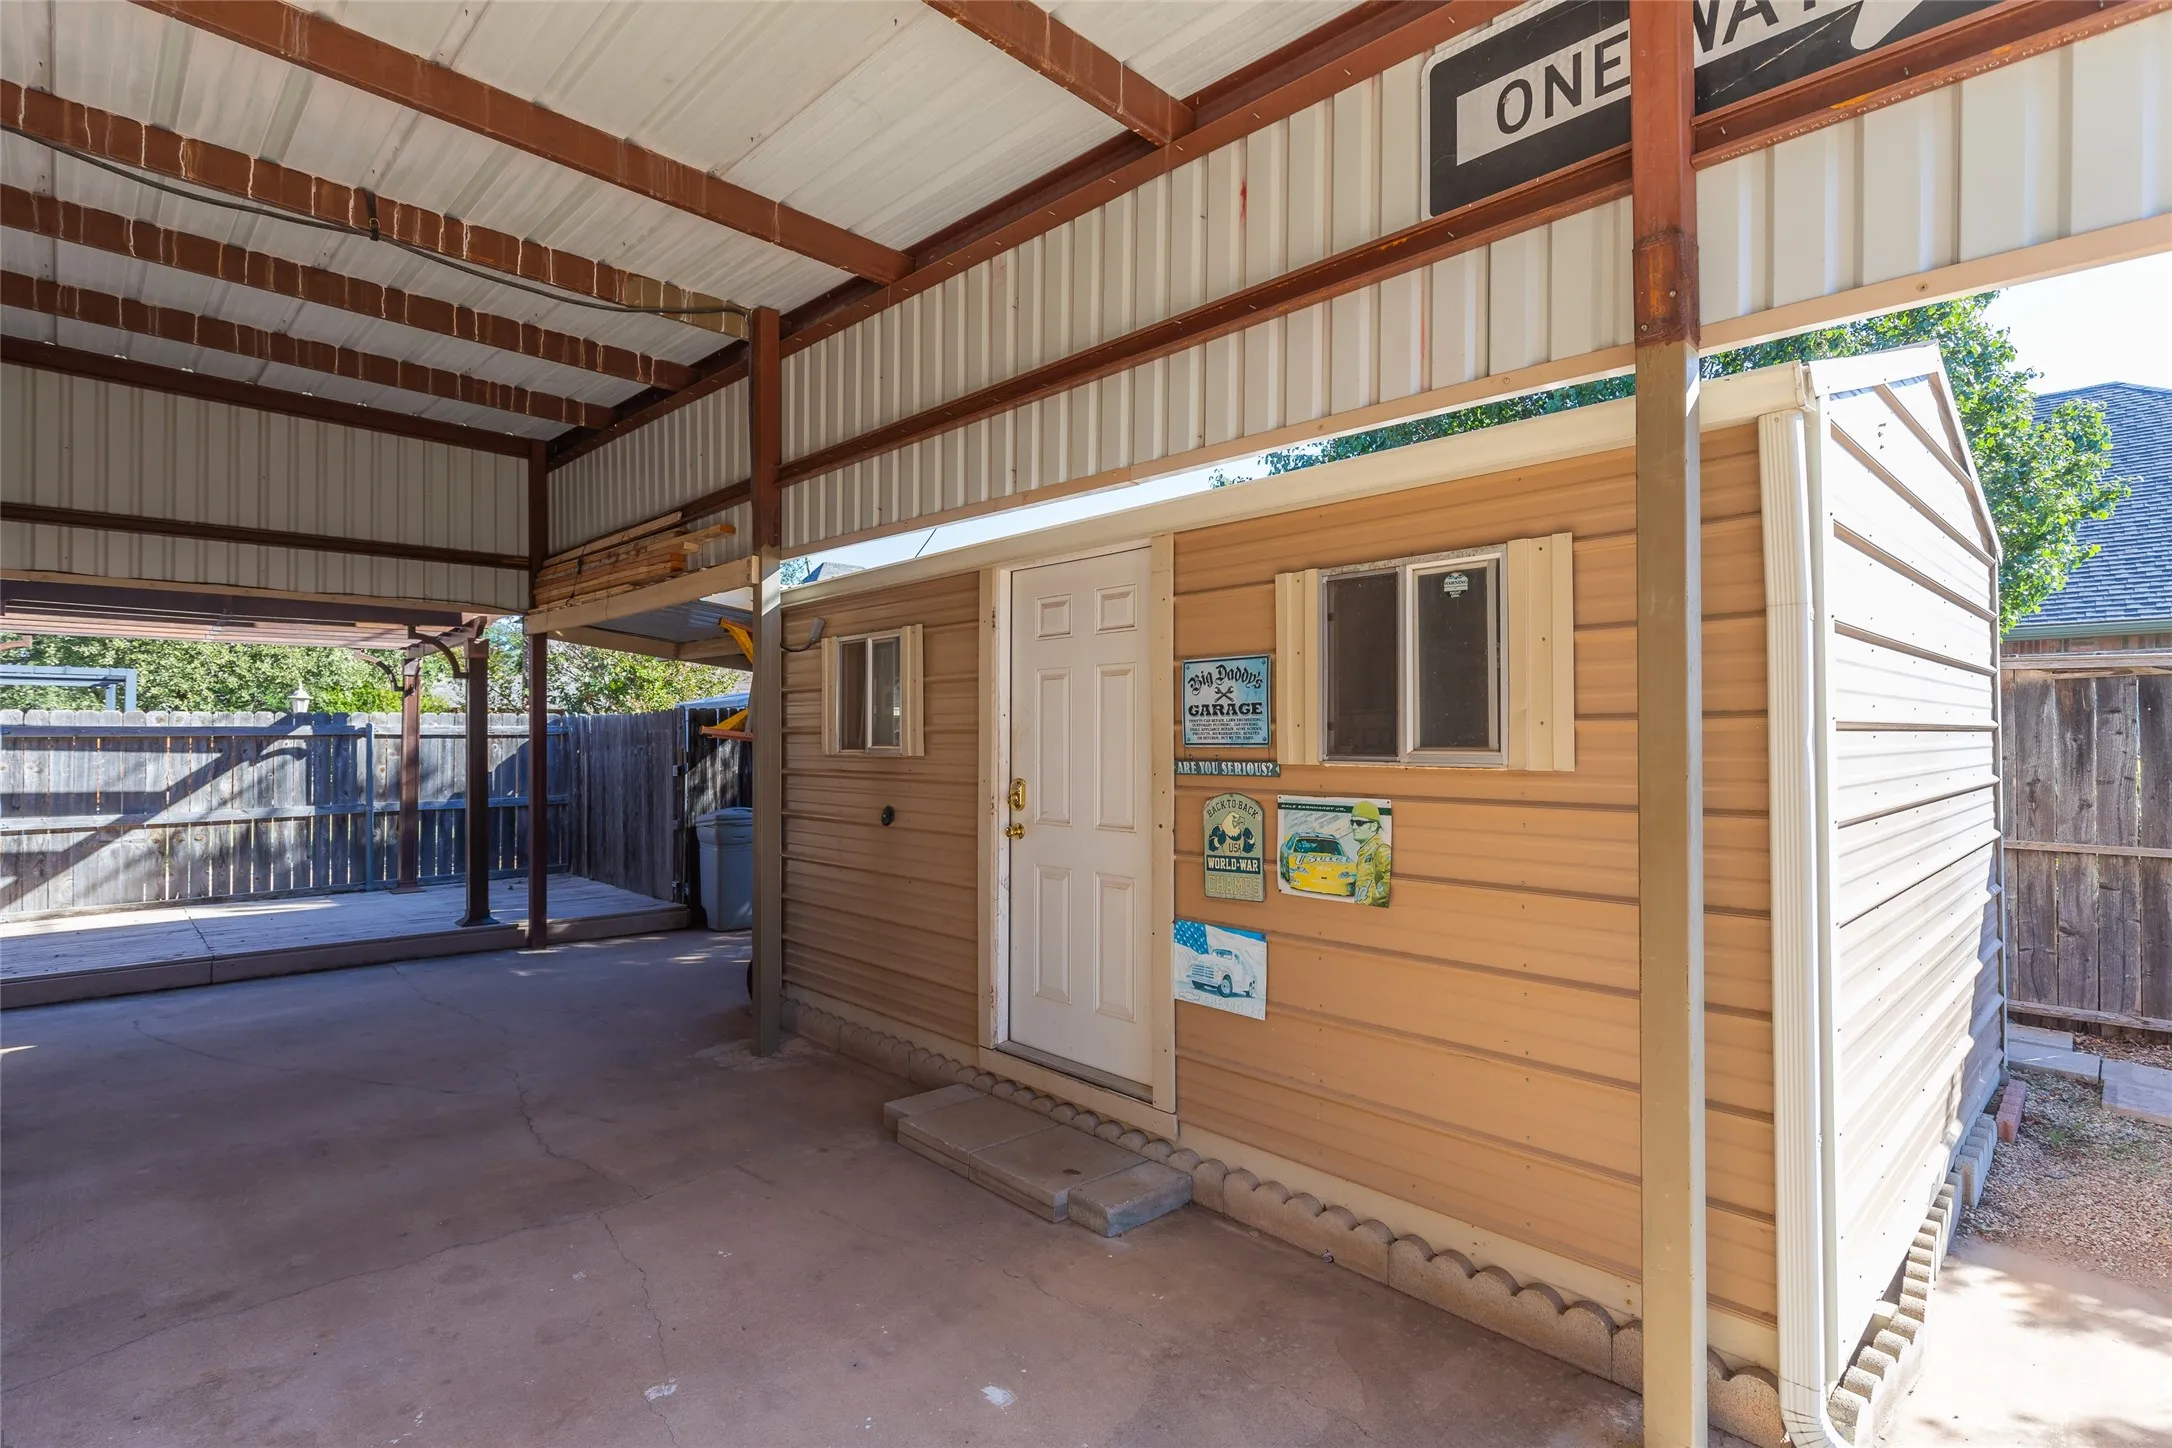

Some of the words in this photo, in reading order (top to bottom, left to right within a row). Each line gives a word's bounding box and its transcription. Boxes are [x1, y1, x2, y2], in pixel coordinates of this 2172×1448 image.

[1497, 30, 1630, 134] ONE
[1720, 143, 1760, 159] MADE
[1767, 135, 1783, 144] IN
[1789, 112, 1849, 136] MEXICO
[1976, 54, 2013, 72] NOT
[1187, 670, 1213, 695] Big
[1215, 664, 1263, 689] Daddy's
[1188, 702, 1263, 717] GARAGE
[1177, 761, 1197, 774] ARE
[1198, 761, 1219, 775] YOU
[1221, 762, 1273, 776] SERIOUS?
[1208, 875, 1260, 897] CHAMPS
